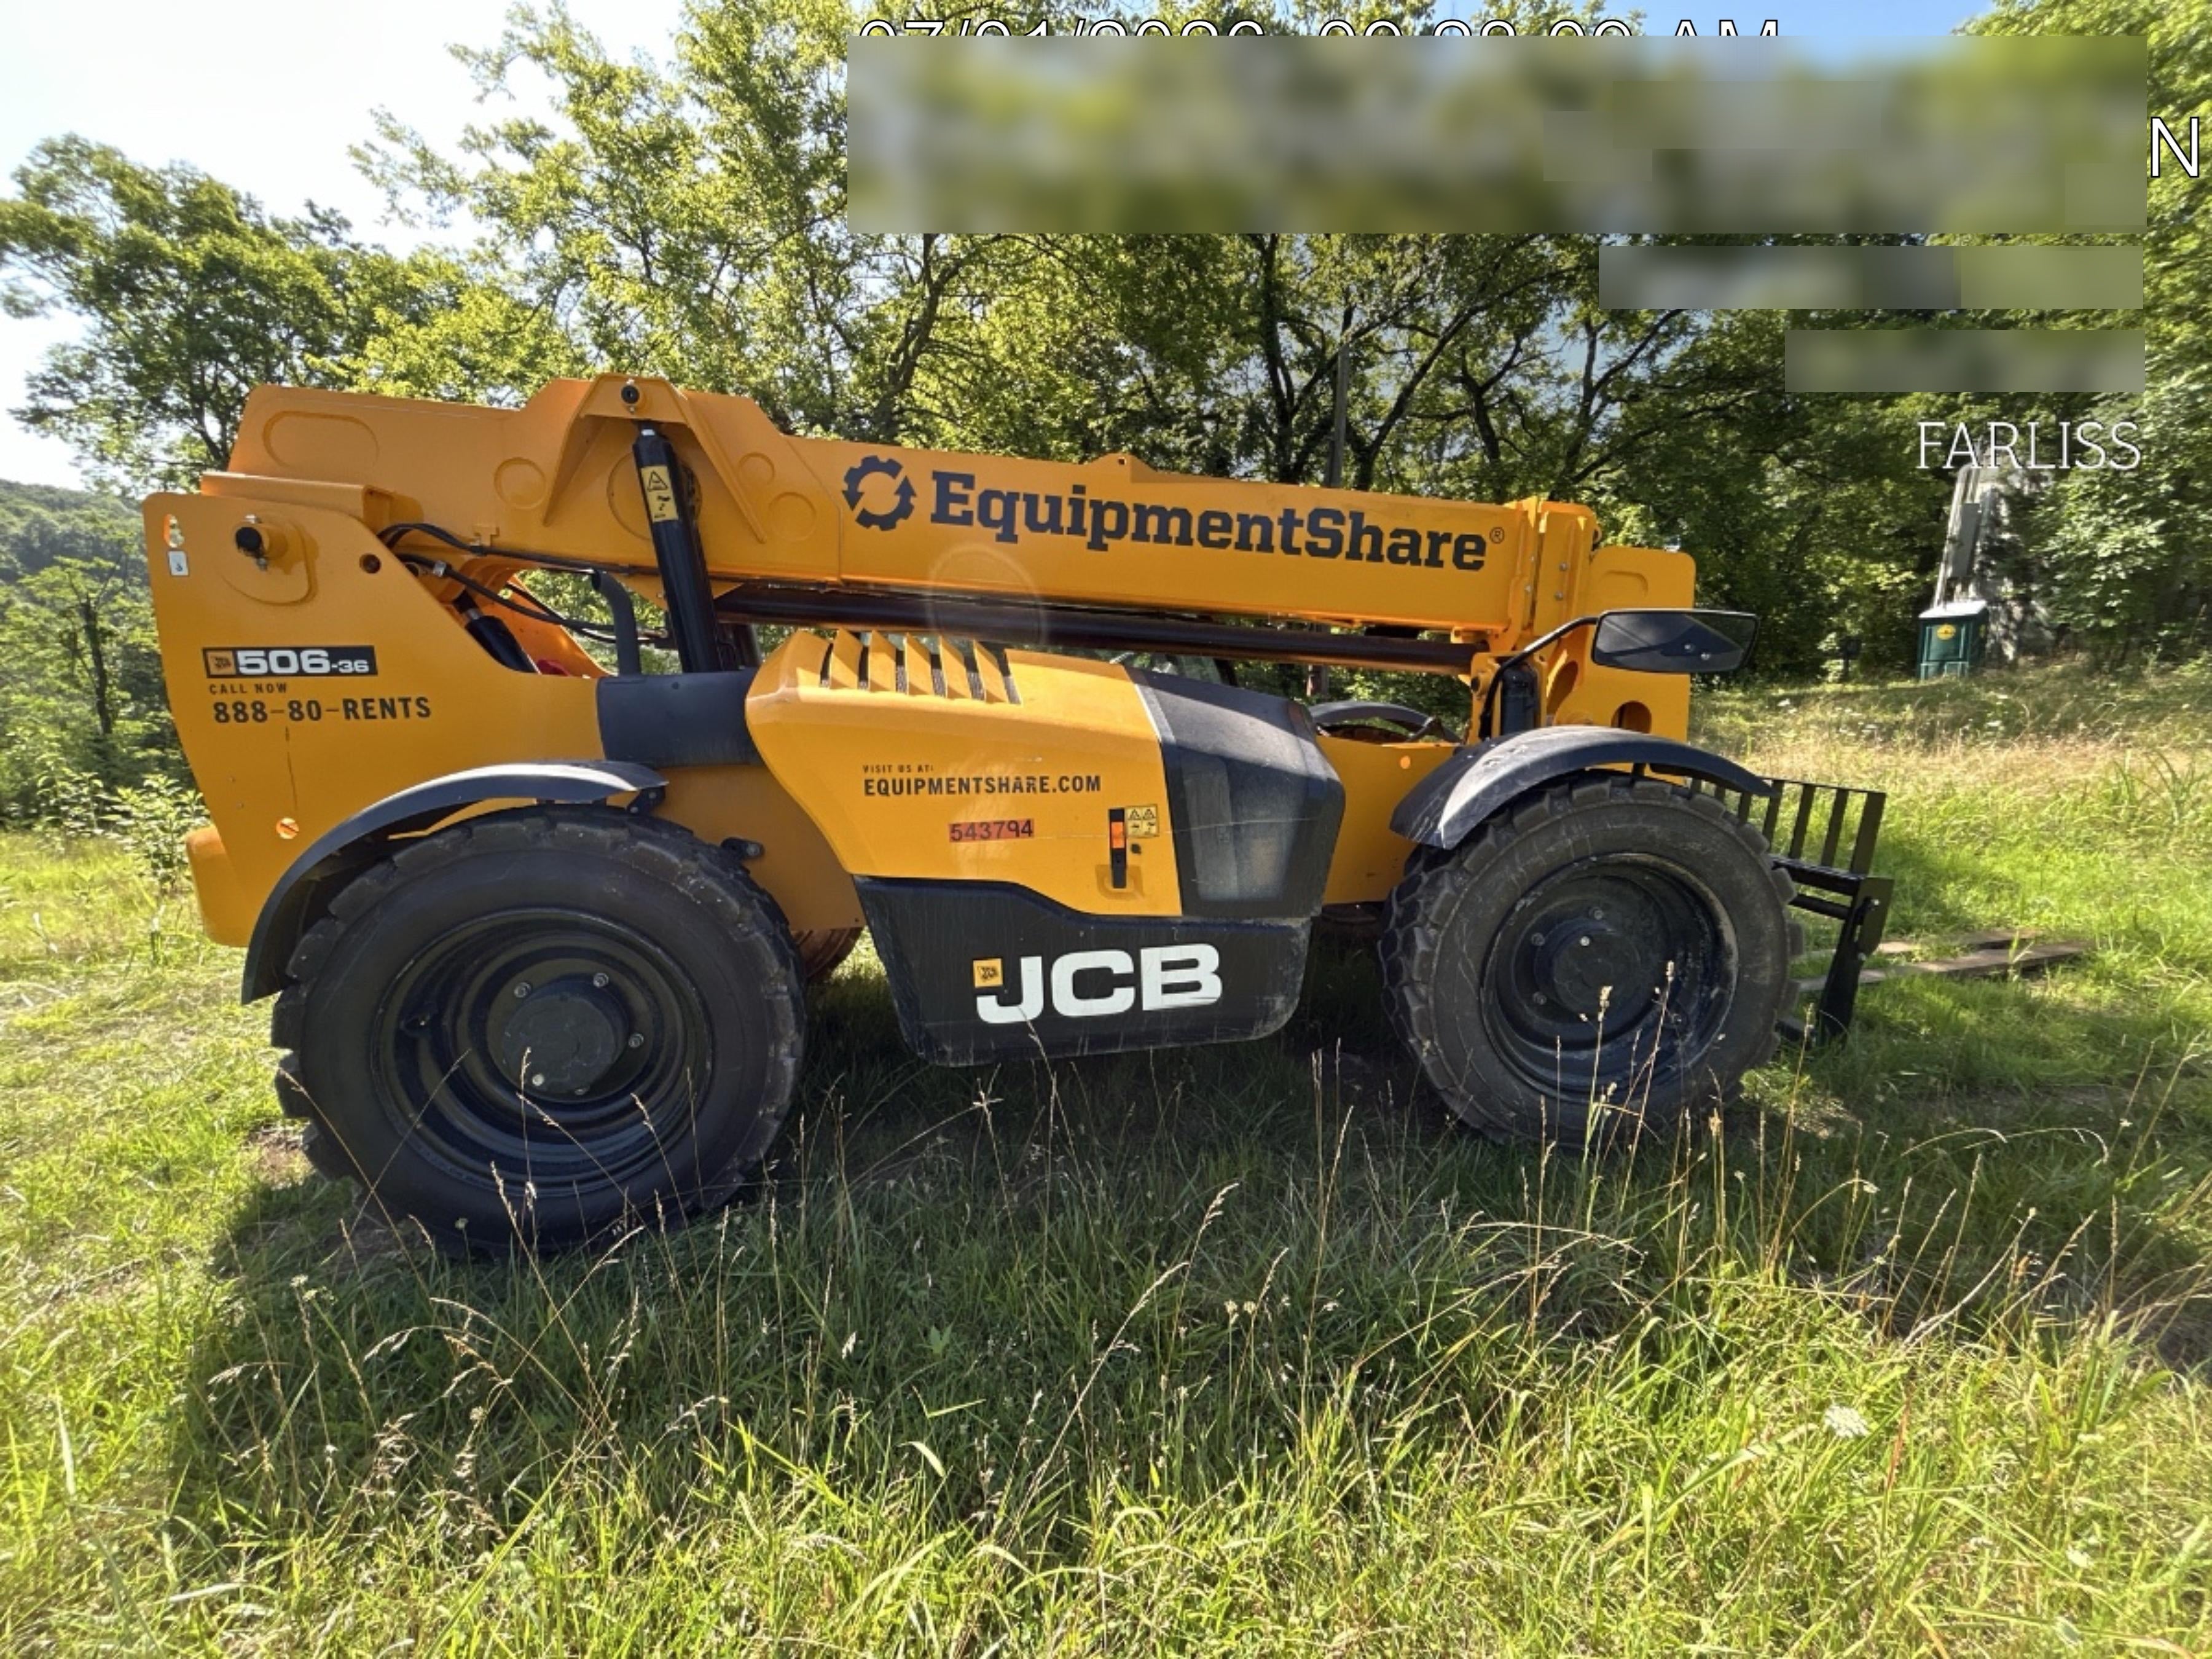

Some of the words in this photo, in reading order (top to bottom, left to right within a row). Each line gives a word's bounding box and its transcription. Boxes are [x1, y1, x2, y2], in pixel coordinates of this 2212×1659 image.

[930, 471, 1487, 572] EquipmentShare
[237, 649, 369, 675] 506-36
[210, 684, 247, 694] CALL
[256, 683, 287, 694] NOW
[213, 697, 431, 724] 888-80-RENTS
[865, 775, 1101, 796] EQUIPMENTSHARE.COM
[951, 819, 1033, 842] 543794
[976, 943, 1223, 1024] JCB
